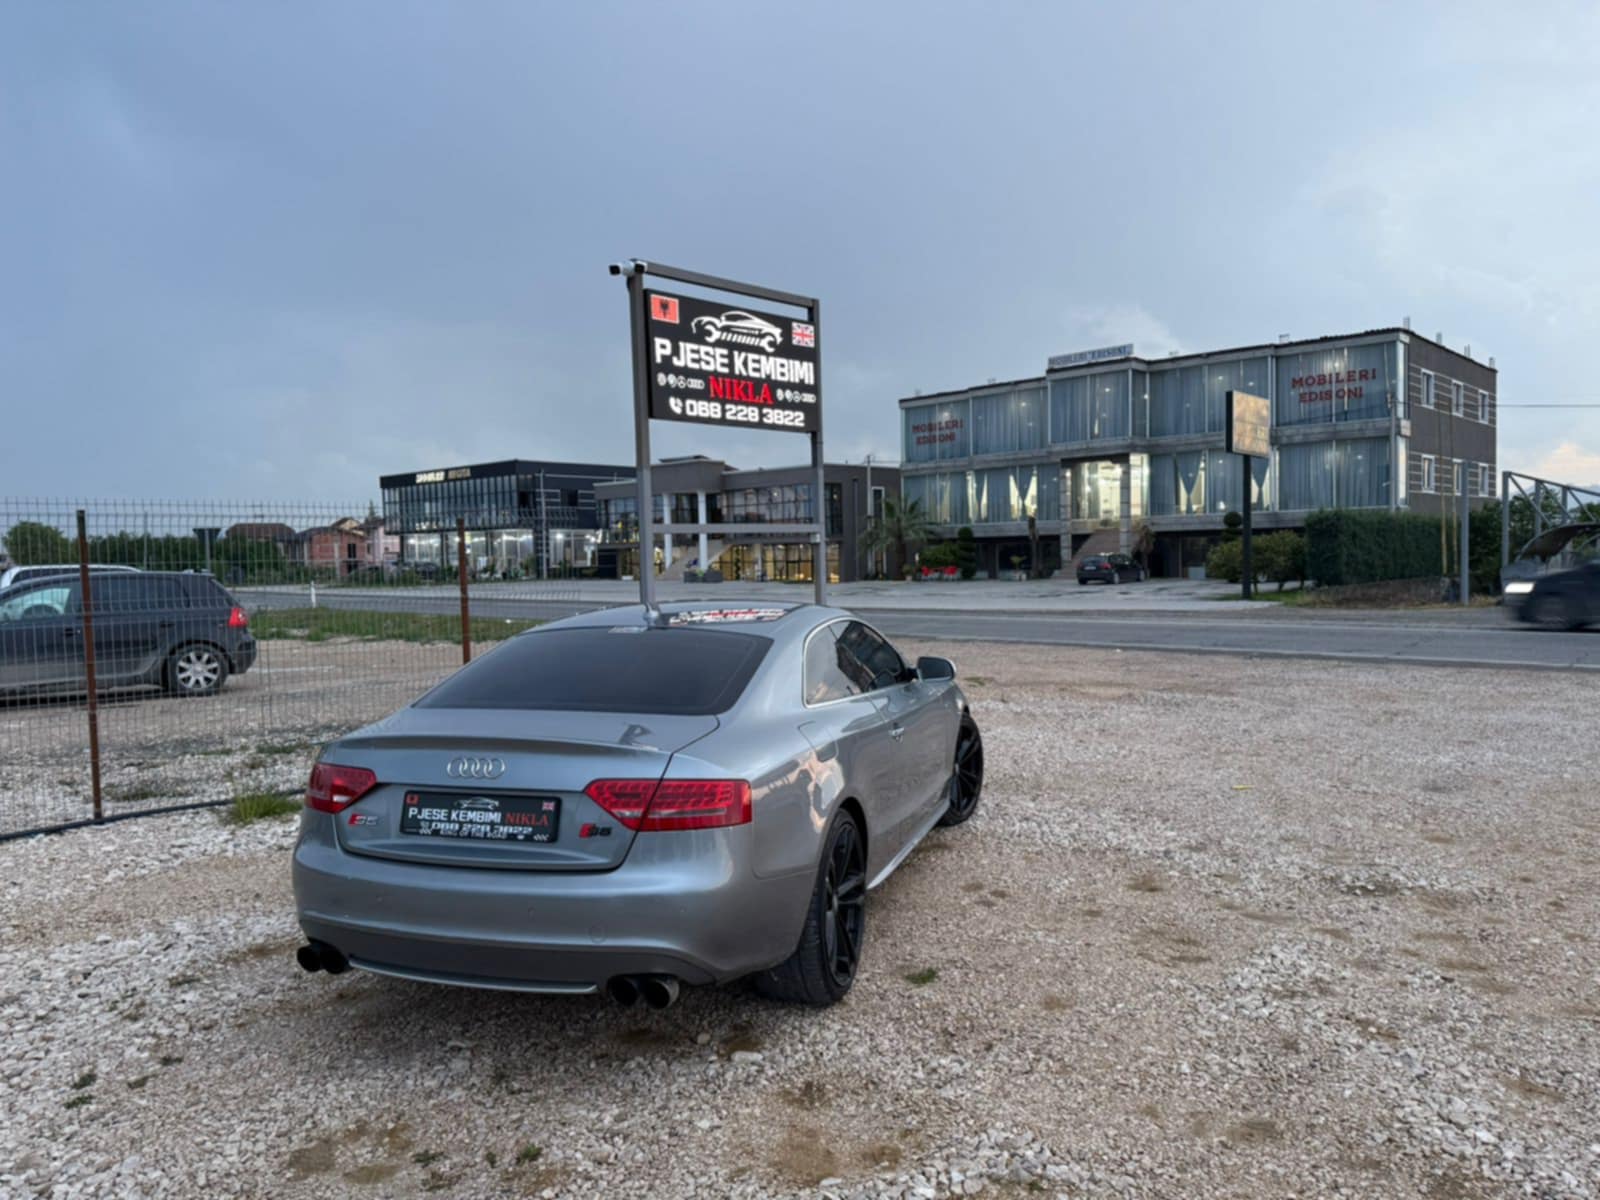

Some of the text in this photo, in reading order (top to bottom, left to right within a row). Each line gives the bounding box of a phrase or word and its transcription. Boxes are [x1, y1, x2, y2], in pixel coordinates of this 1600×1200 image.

[733, 351, 814, 385] KEMBIMI
[1291, 368, 1377, 389] MOBILERI
[708, 375, 774, 405] NIKLA
[1299, 386, 1363, 403] EDISONI
[686, 400, 805, 427] 068 228 3822
[408, 807, 549, 826] PJESE KEMBIMI NIKLA
